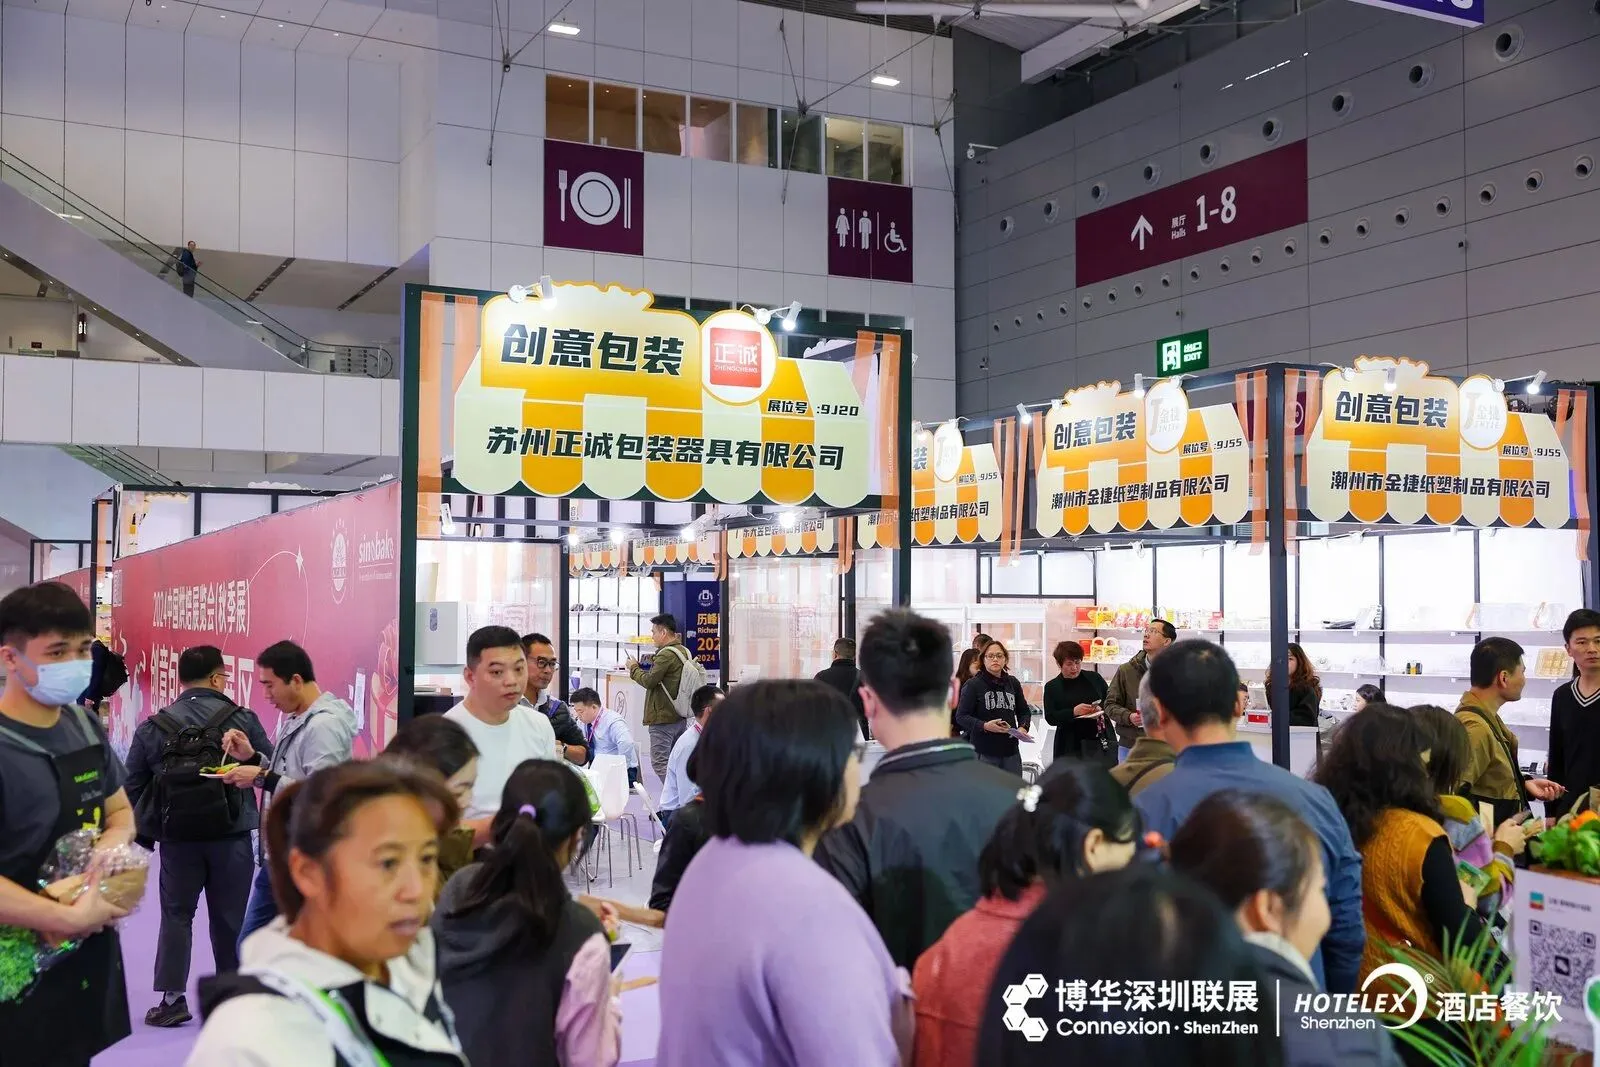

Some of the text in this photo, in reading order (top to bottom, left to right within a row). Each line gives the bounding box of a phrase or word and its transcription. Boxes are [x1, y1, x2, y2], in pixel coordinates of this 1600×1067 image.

[1196, 186, 1236, 232] 1-8
[1172, 214, 1186, 228] 展厅
[1172, 228, 1186, 240] Halls
[500, 323, 685, 377] 创意包装
[713, 343, 758, 366] 正诚
[1184, 342, 1202, 352] 出口
[1184, 352, 1202, 362] EXIT
[714, 364, 758, 374] ZHENGCHENG
[766, 399, 860, 417] 展位号 :9J20
[1334, 390, 1448, 428] 创意包装
[1054, 412, 1136, 450] 创意包装
[486, 426, 844, 470] 苏州正诚包装器具有限公司
[1182, 438, 1242, 454] 展位号 :9J55
[1502, 445, 1561, 457] 展位号 :9J55
[1051, 474, 1230, 510] 潮州市金捷纸塑制品有限公司
[1330, 470, 1550, 498] 潮州市金捷纸塑制品有限公司
[359, 530, 394, 563] sinobake
[697, 613, 720, 626] 历峰
[984, 691, 1016, 711] GAP
